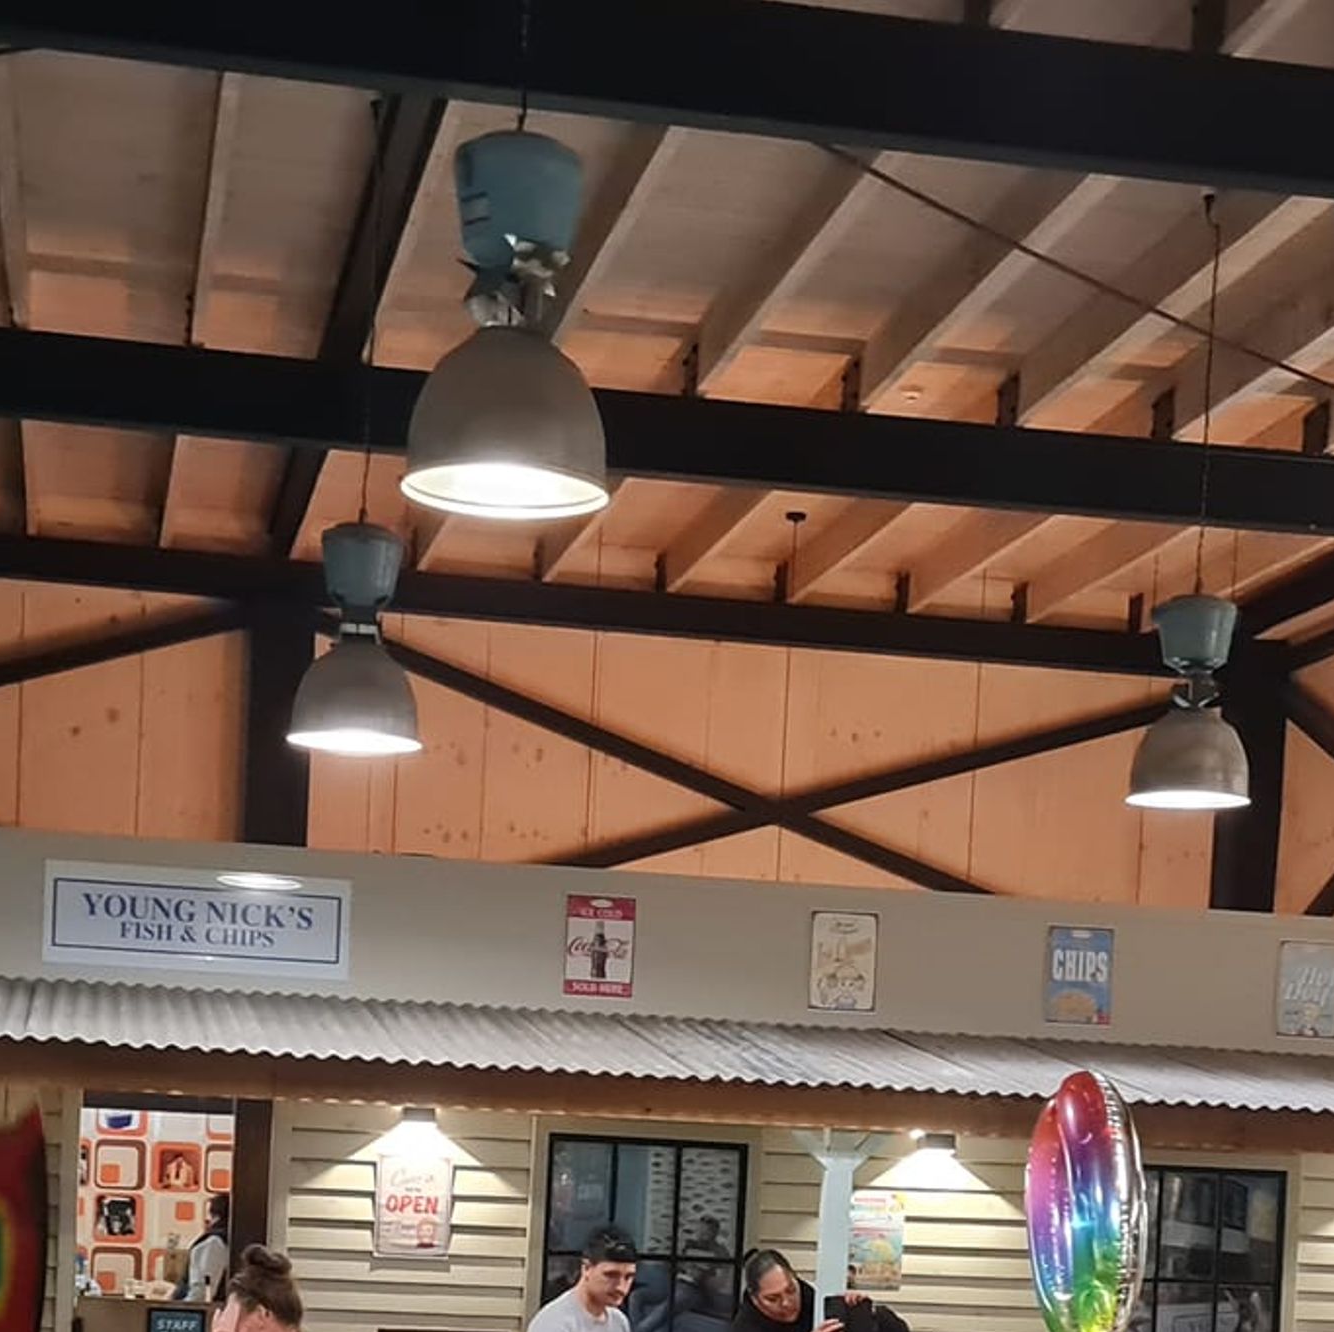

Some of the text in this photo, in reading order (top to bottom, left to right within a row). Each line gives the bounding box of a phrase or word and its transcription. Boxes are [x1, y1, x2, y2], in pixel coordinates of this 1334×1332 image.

[82, 892, 314, 931] YOUNG NICK'S
[119, 921, 276, 948] FISH & CHIPS
[1052, 948, 1109, 983] CHIPS
[385, 1194, 439, 1215] OPEN
[156, 1318, 198, 1330] STAFF
